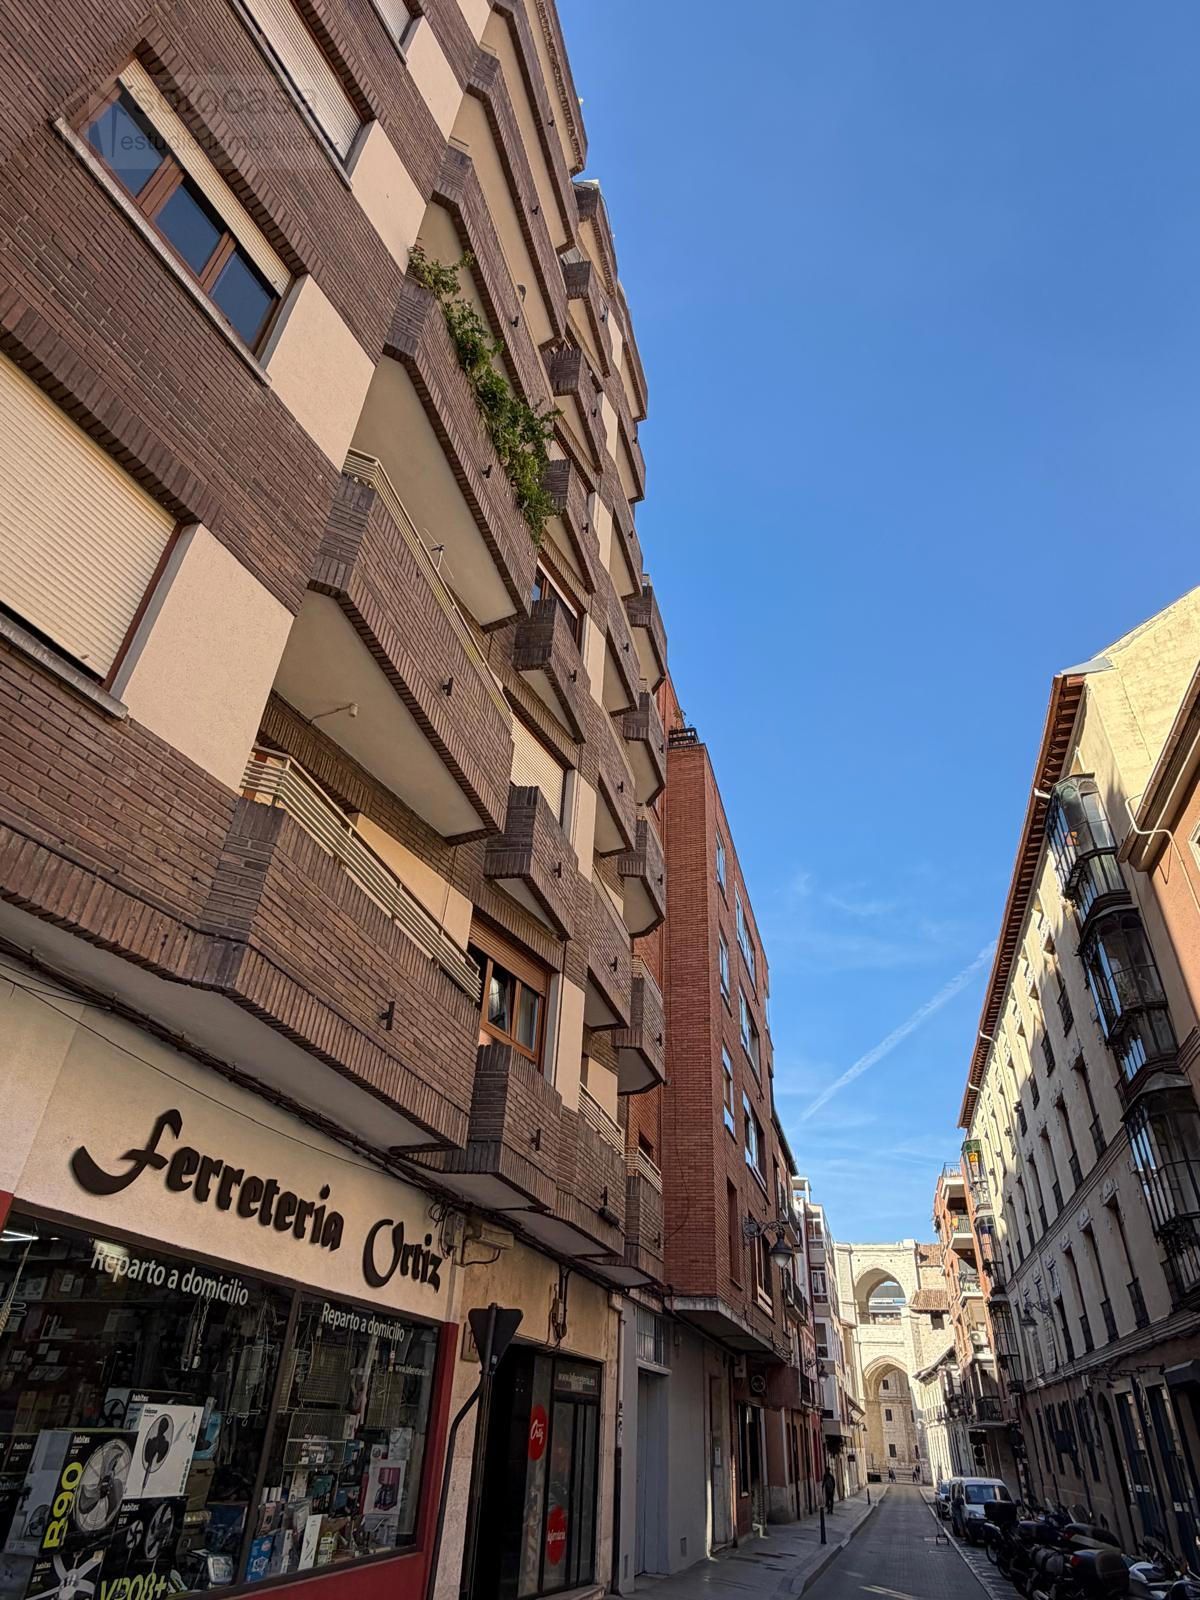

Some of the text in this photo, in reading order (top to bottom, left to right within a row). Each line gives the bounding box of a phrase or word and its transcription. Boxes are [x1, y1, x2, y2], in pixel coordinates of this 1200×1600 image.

[90, 1245, 249, 1307] Reparto a domicilio
[362, 1218, 442, 1294] Ortiz
[321, 1302, 405, 1343] Reparto a domicilio
[42, 1461, 84, 1549] B90
